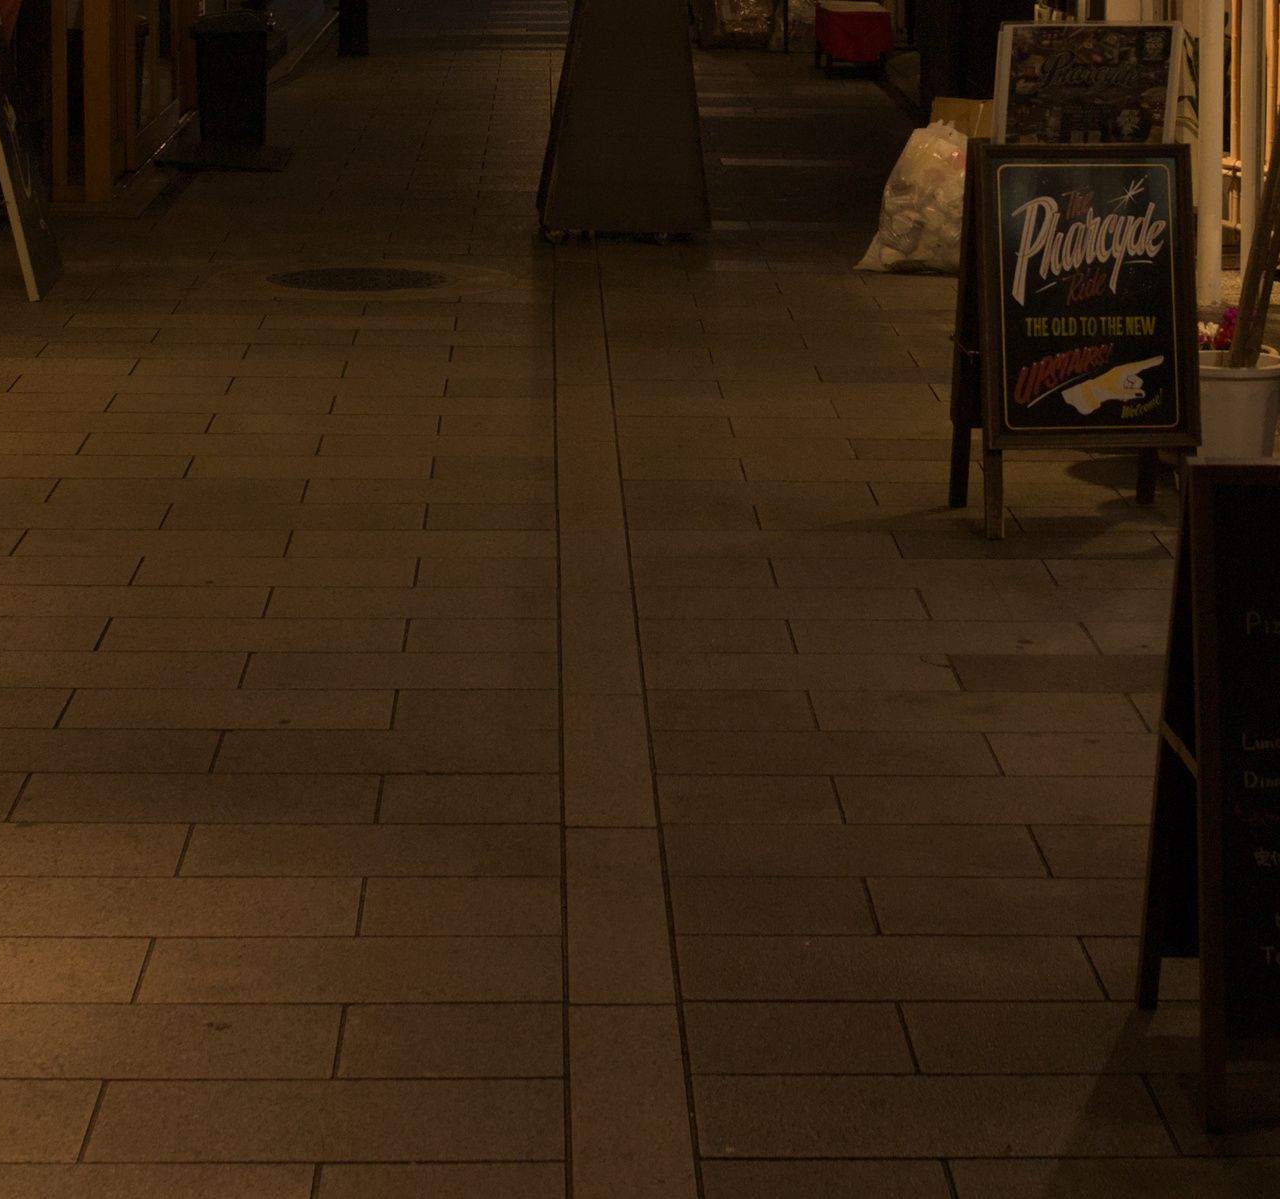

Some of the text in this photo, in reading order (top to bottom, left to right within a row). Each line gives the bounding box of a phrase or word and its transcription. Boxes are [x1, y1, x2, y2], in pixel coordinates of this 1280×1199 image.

[1011, 195, 1167, 308] Pharcyde
[1061, 270, 1108, 306] Ride
[1025, 315, 1157, 337] THE OLD TO THE NEW
